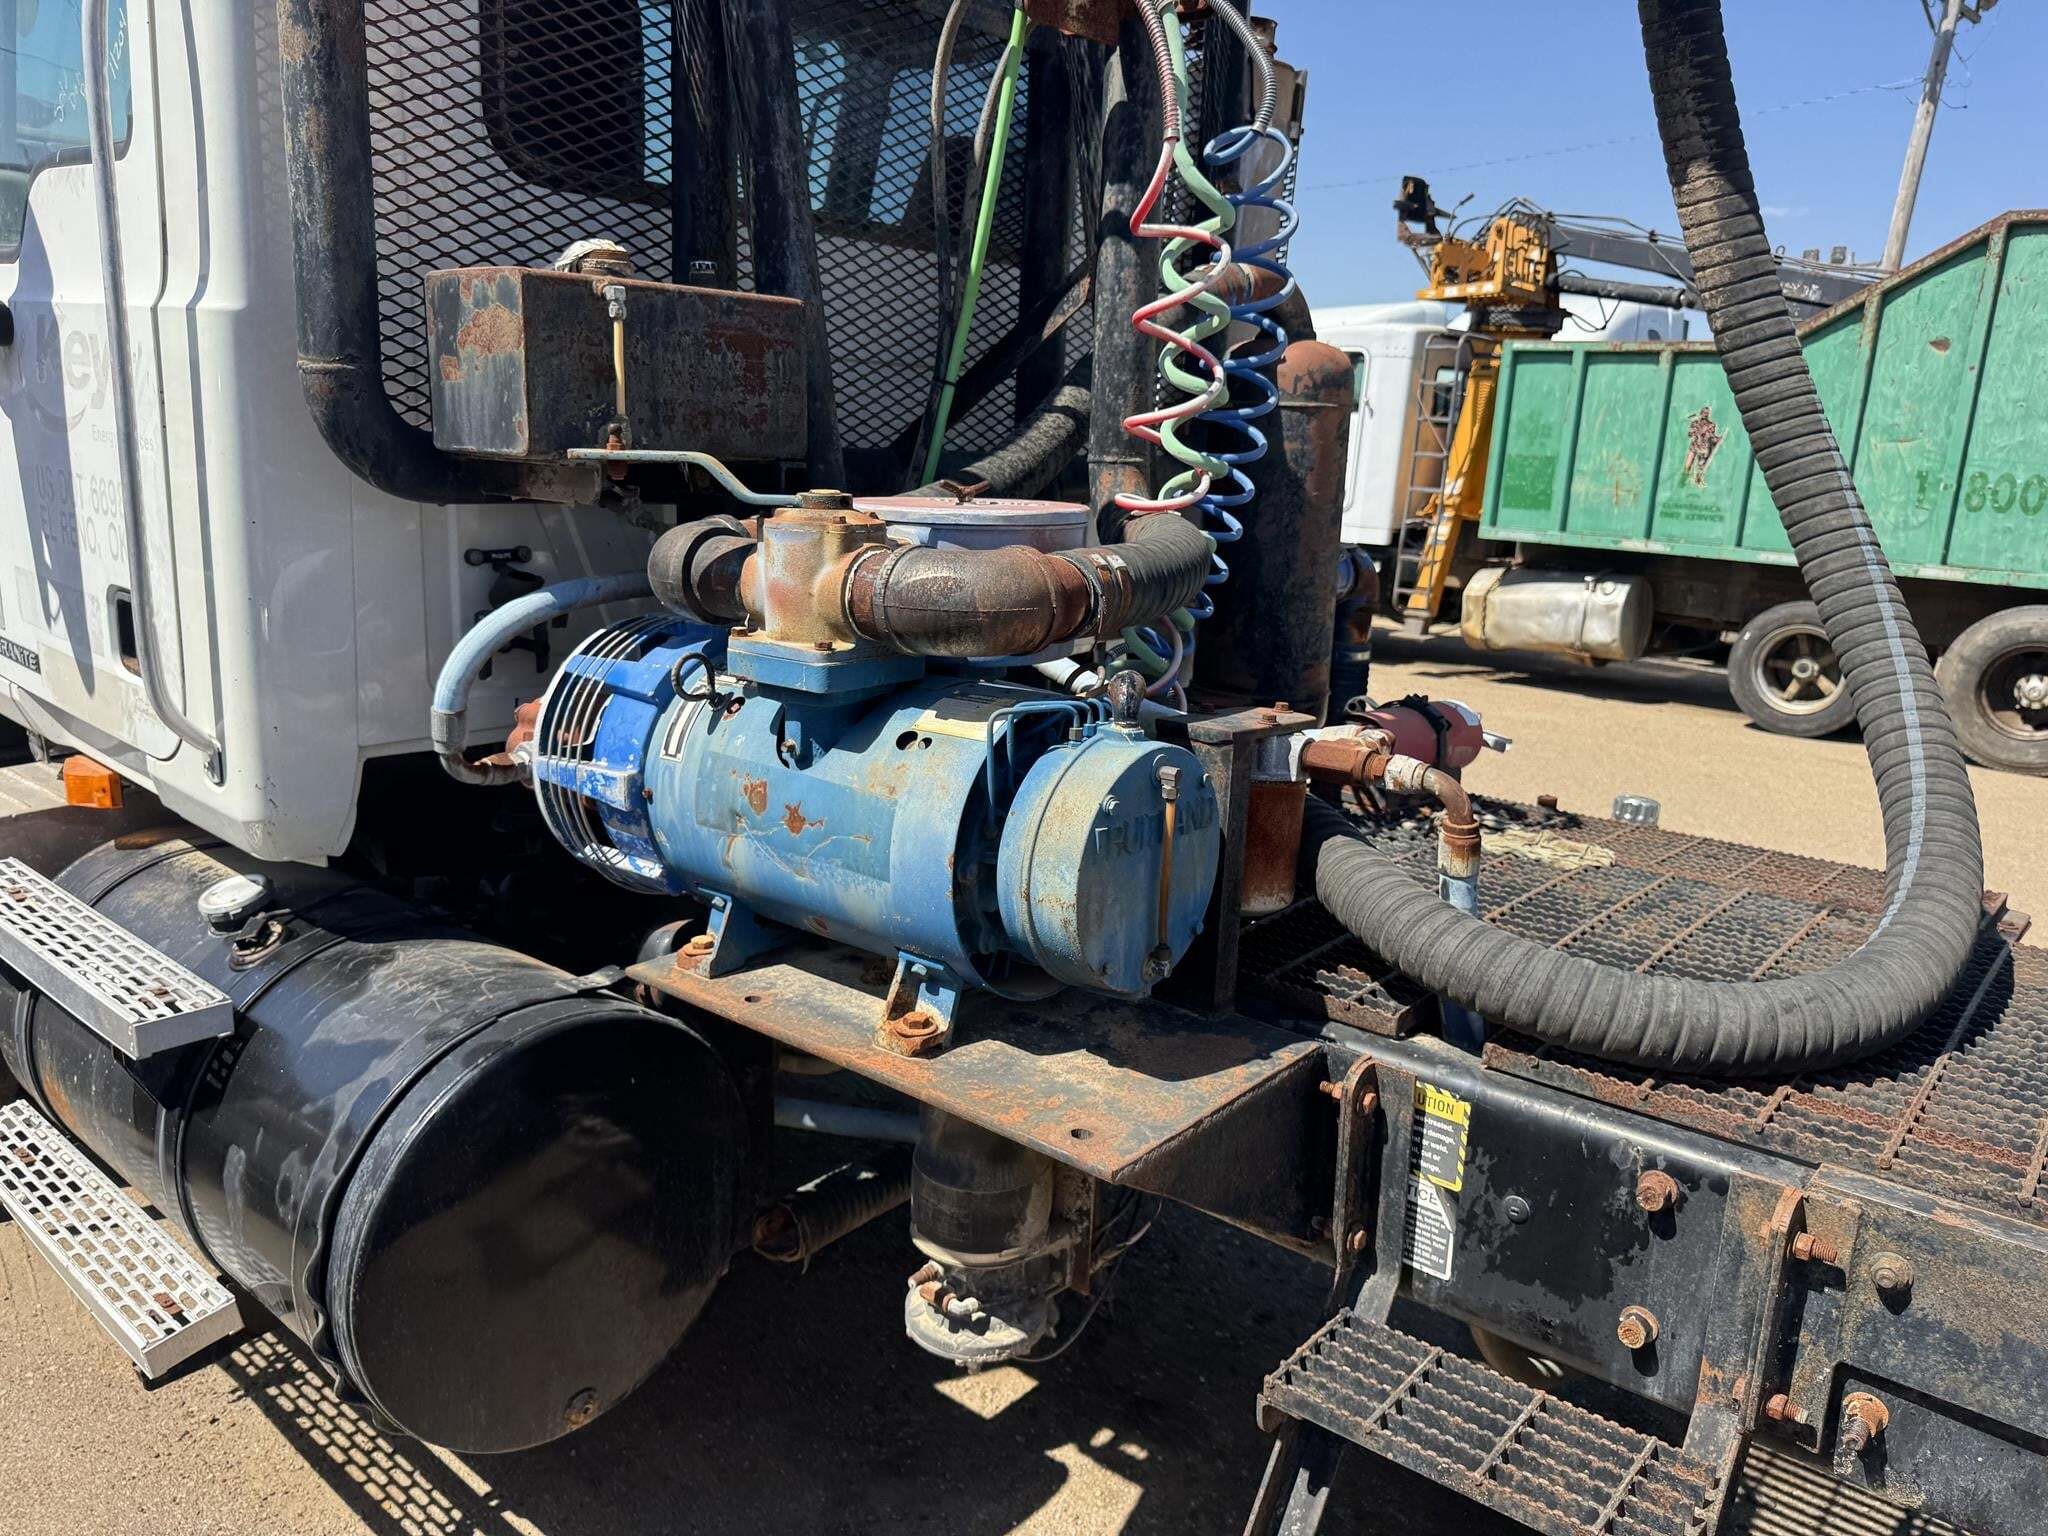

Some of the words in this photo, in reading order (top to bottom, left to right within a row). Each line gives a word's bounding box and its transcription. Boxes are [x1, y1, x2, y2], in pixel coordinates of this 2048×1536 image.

[0, 638, 40, 672] RANITE
[1416, 1091, 1455, 1116] UTION
[1408, 1184, 1440, 1208] TICE
